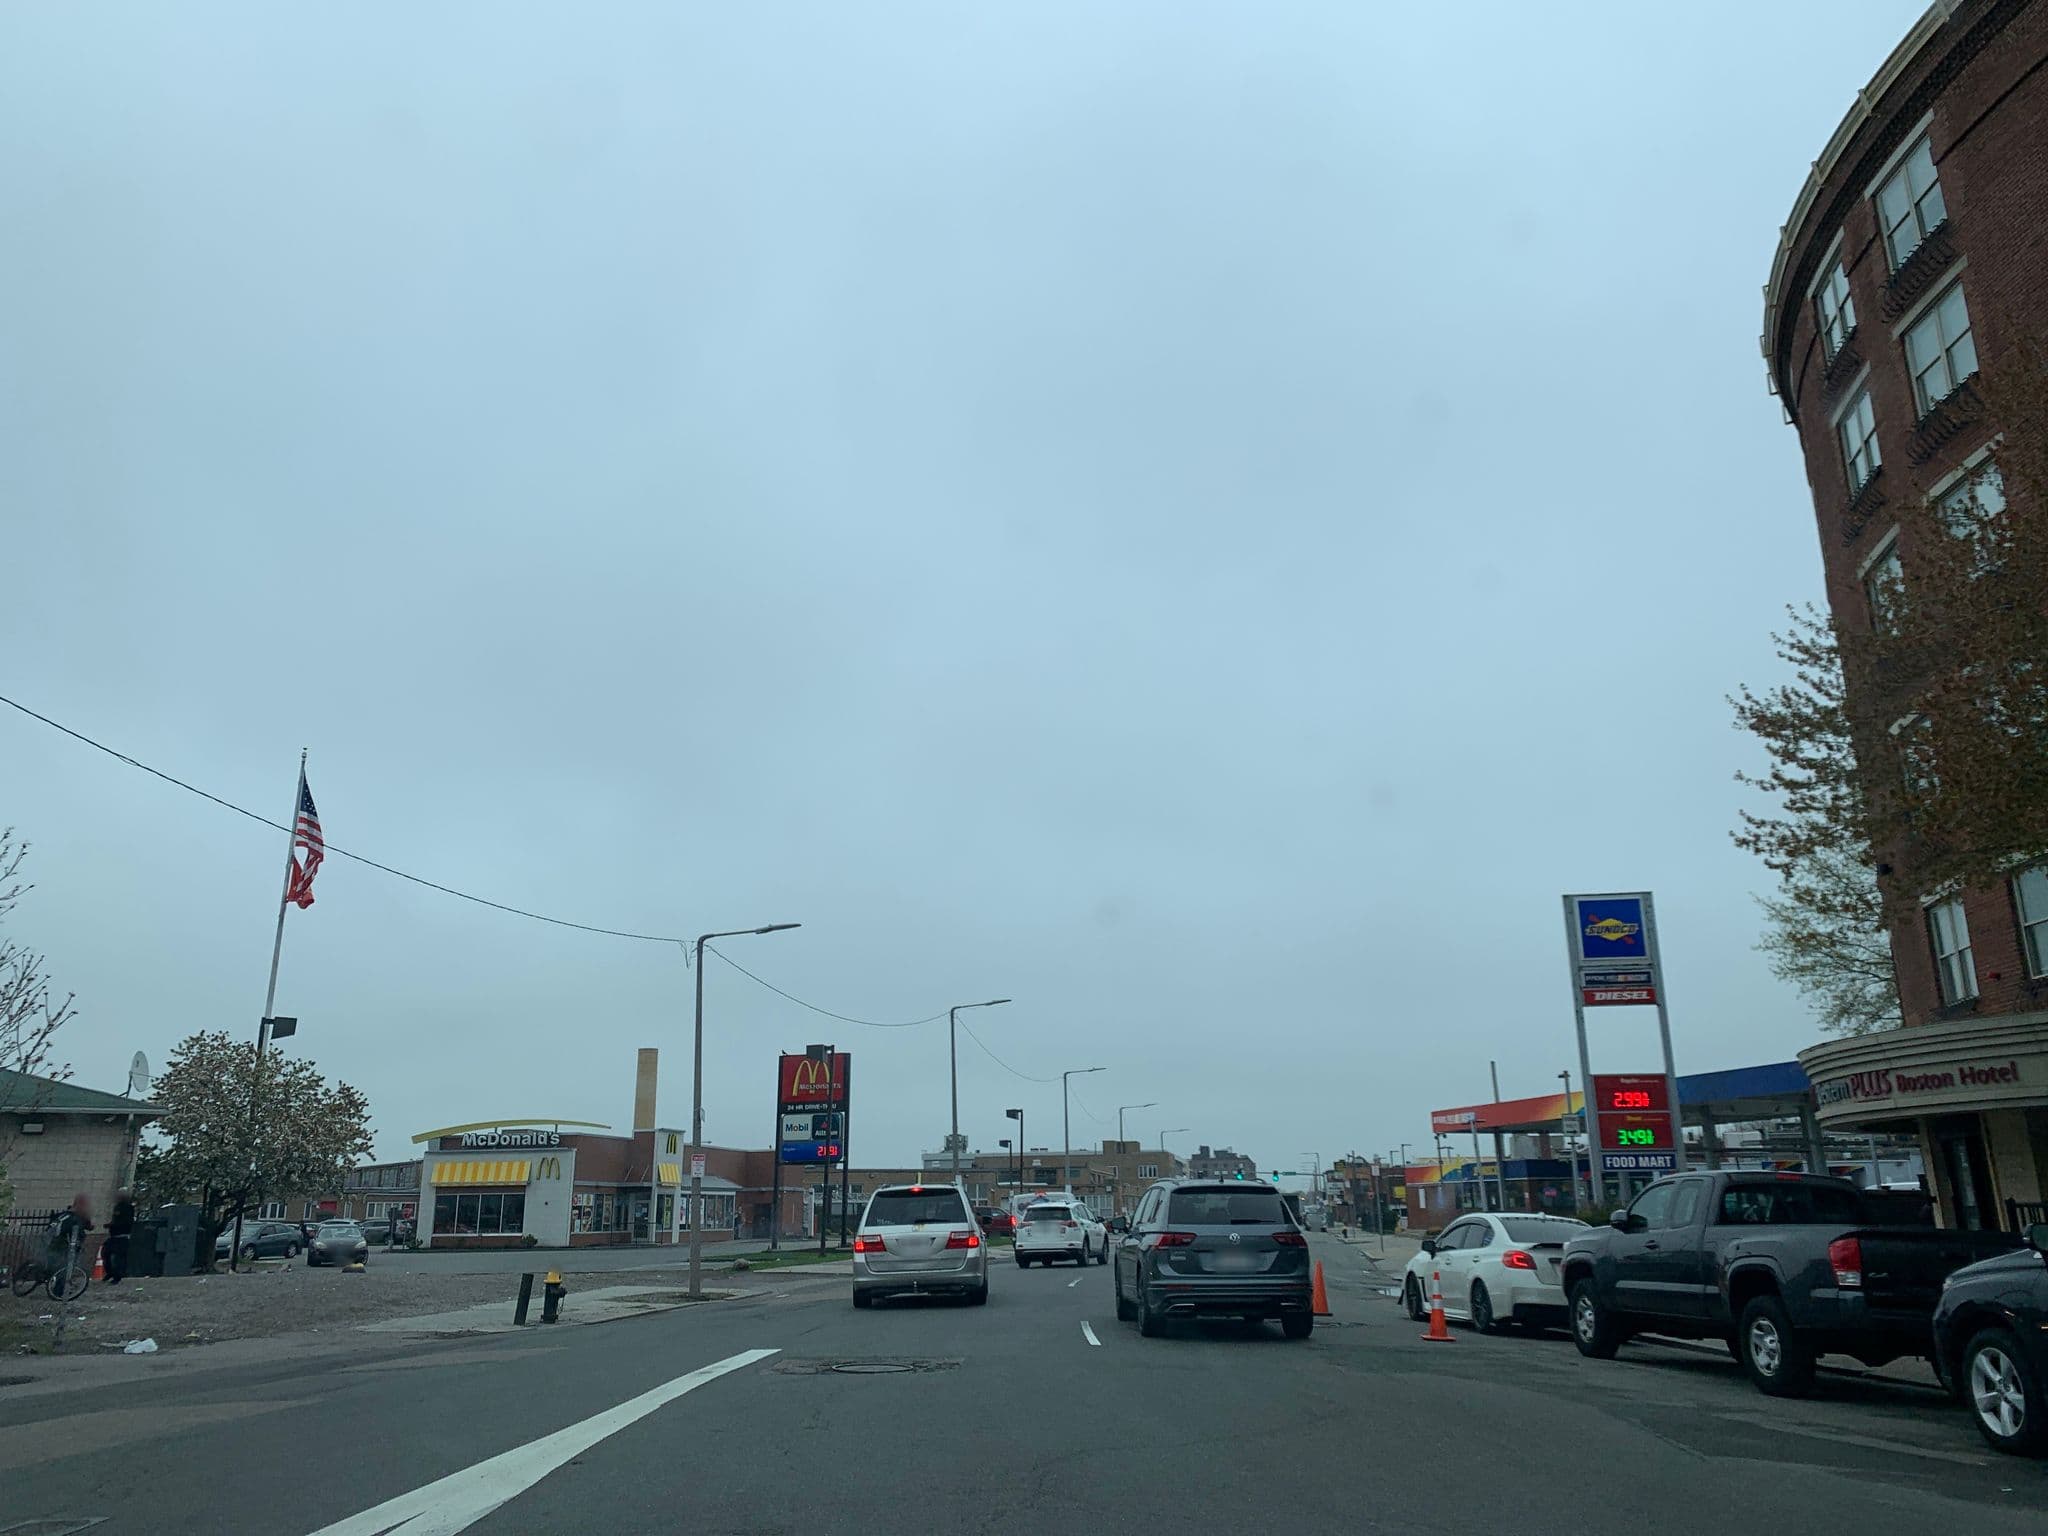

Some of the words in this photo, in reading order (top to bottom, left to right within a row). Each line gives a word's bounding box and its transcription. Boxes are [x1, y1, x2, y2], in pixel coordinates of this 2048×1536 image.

[1592, 990, 1650, 1001] DIESEL
[1850, 1070, 1892, 1098] PLUS
[1895, 1072, 1954, 1094] Boston
[1958, 1060, 2020, 1086] Hotel
[785, 1123, 809, 1132] Mobil
[461, 1131, 560, 1147] McDonald's
[1606, 1156, 1636, 1168] FOOD
[1639, 1155, 1672, 1167] MART
